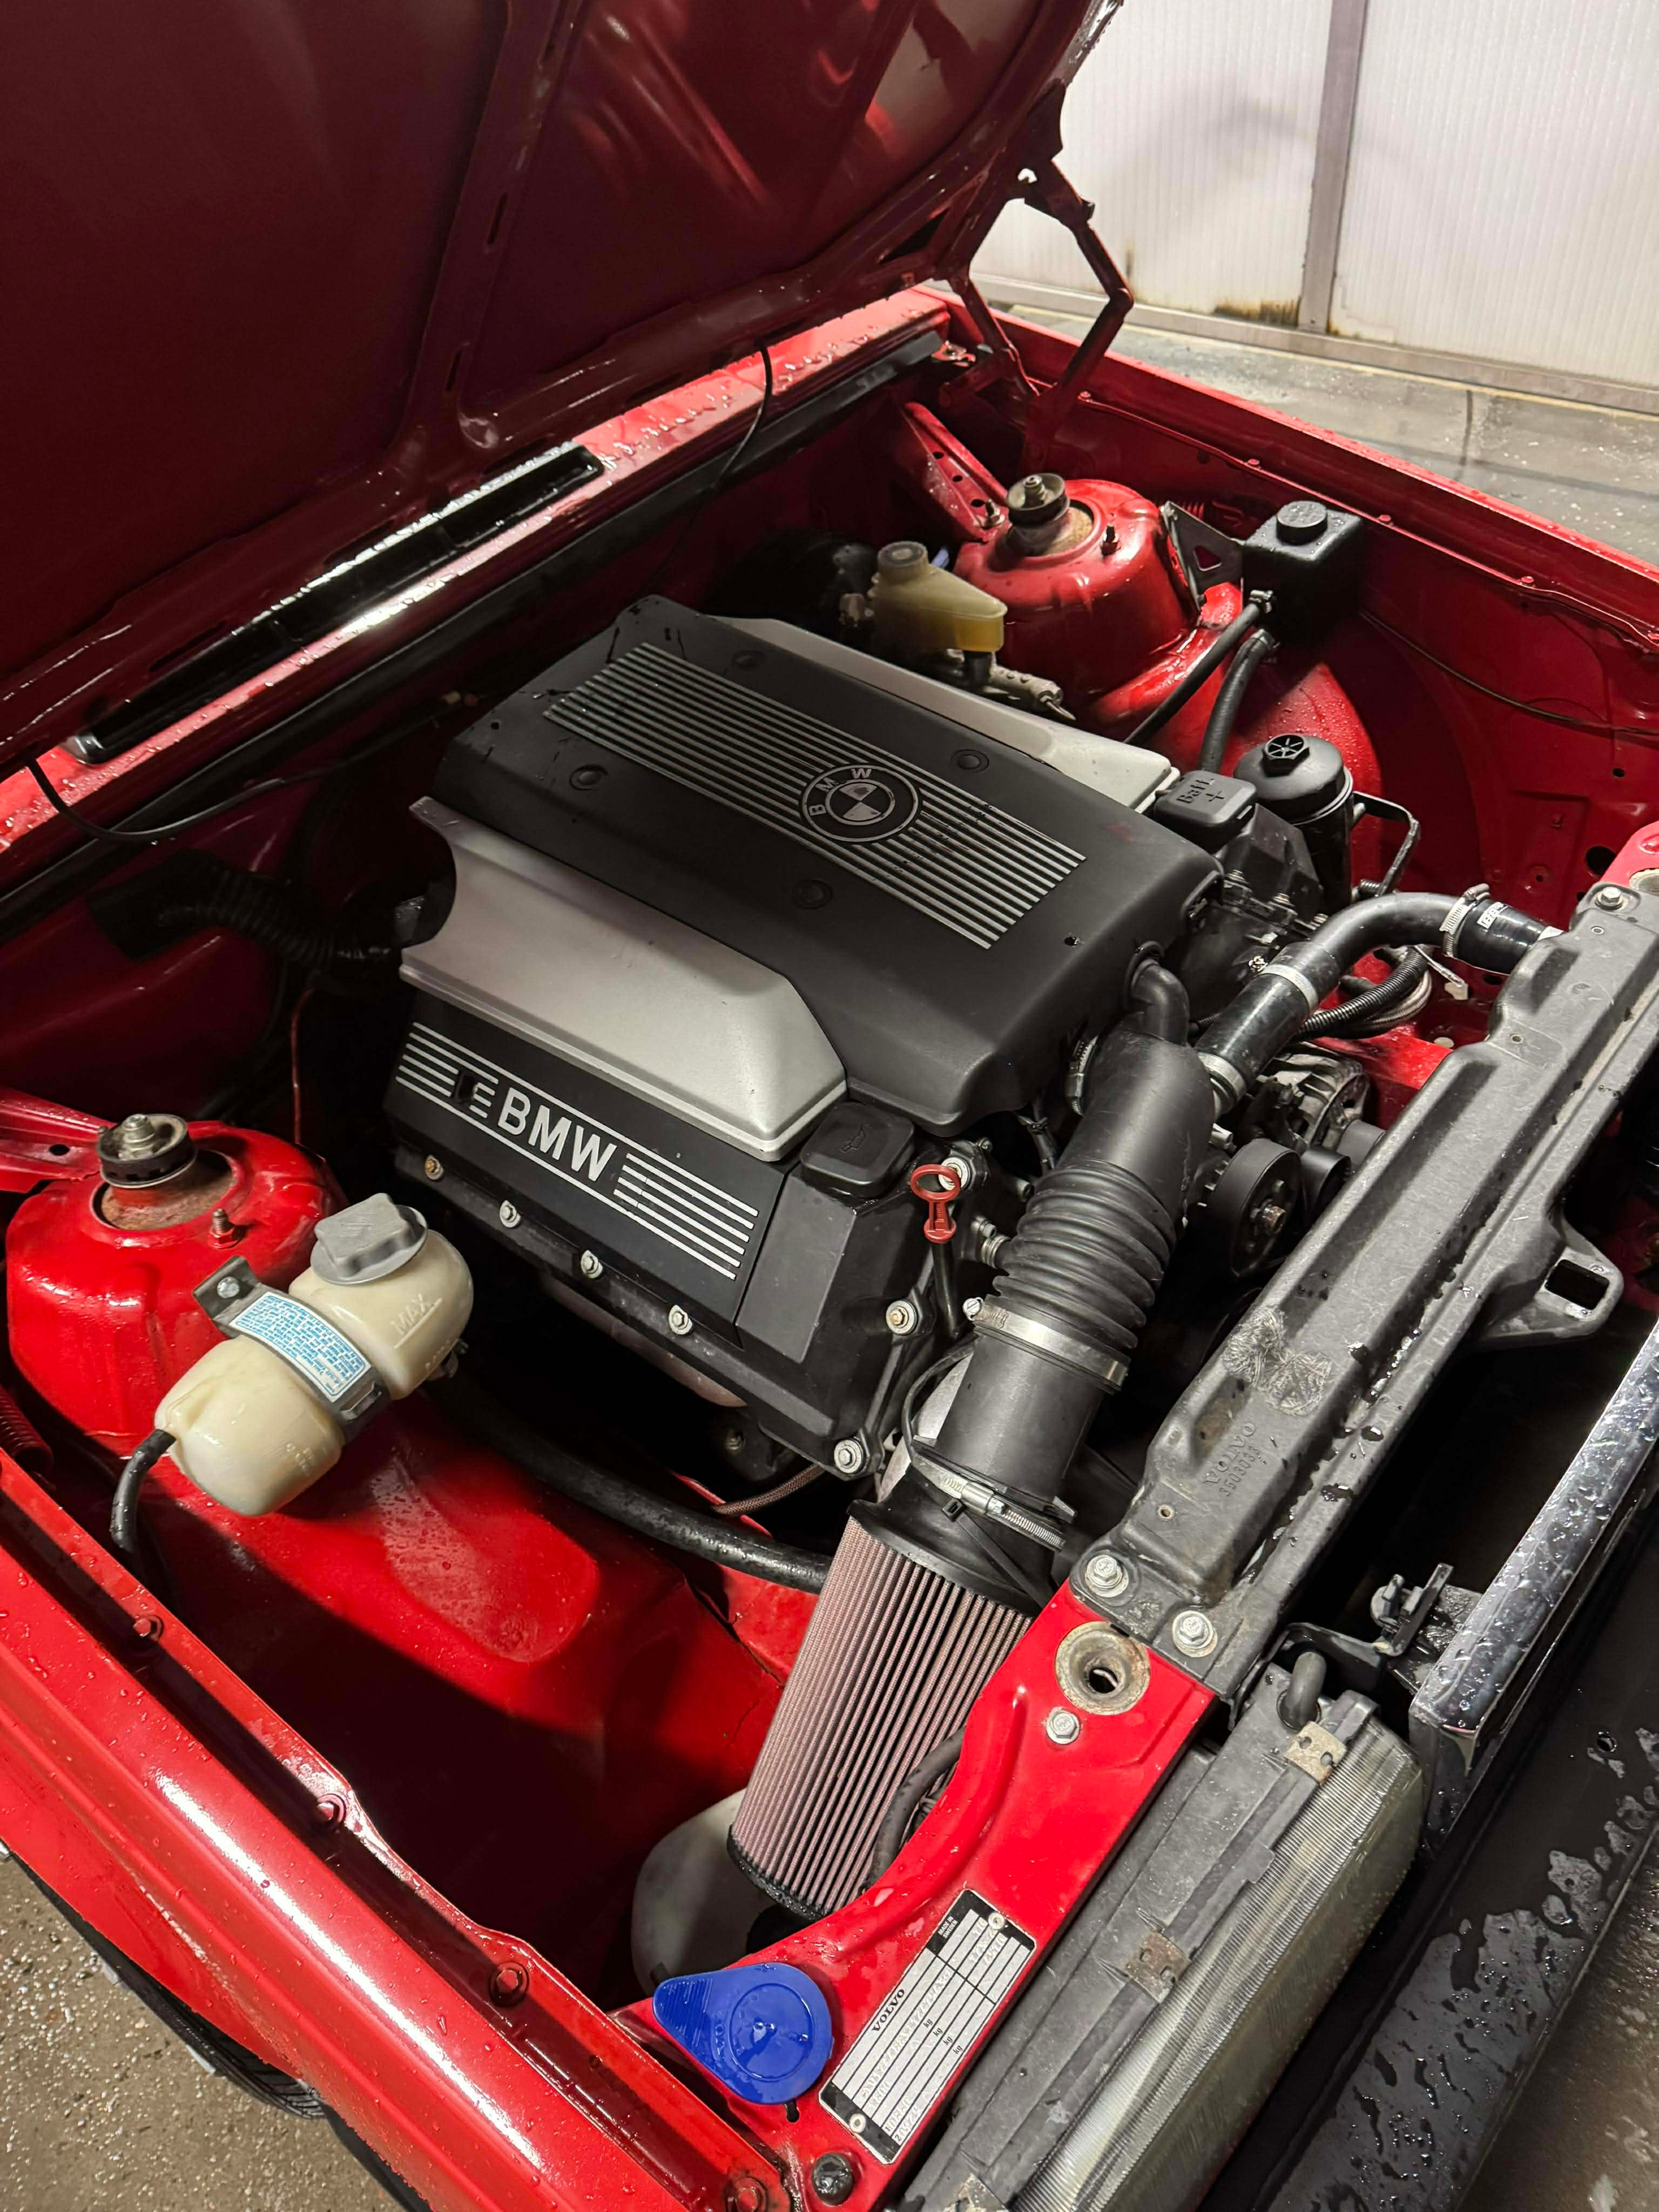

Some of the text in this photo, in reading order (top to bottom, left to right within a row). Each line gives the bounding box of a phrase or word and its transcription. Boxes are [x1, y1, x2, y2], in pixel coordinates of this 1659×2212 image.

[808, 768, 872, 817] BMW
[497, 1087, 618, 1182] BMW
[390, 1293, 431, 1336] MAX
[1203, 1422, 1257, 1485] VOLVO
[938, 1921, 950, 1936] MADE
[871, 1988, 906, 2033] VOLVO
[923, 2019, 933, 2028] kg
[933, 2027, 943, 2036] kg
[942, 2036, 953, 2046] kg
[952, 2045, 963, 2054] kg
